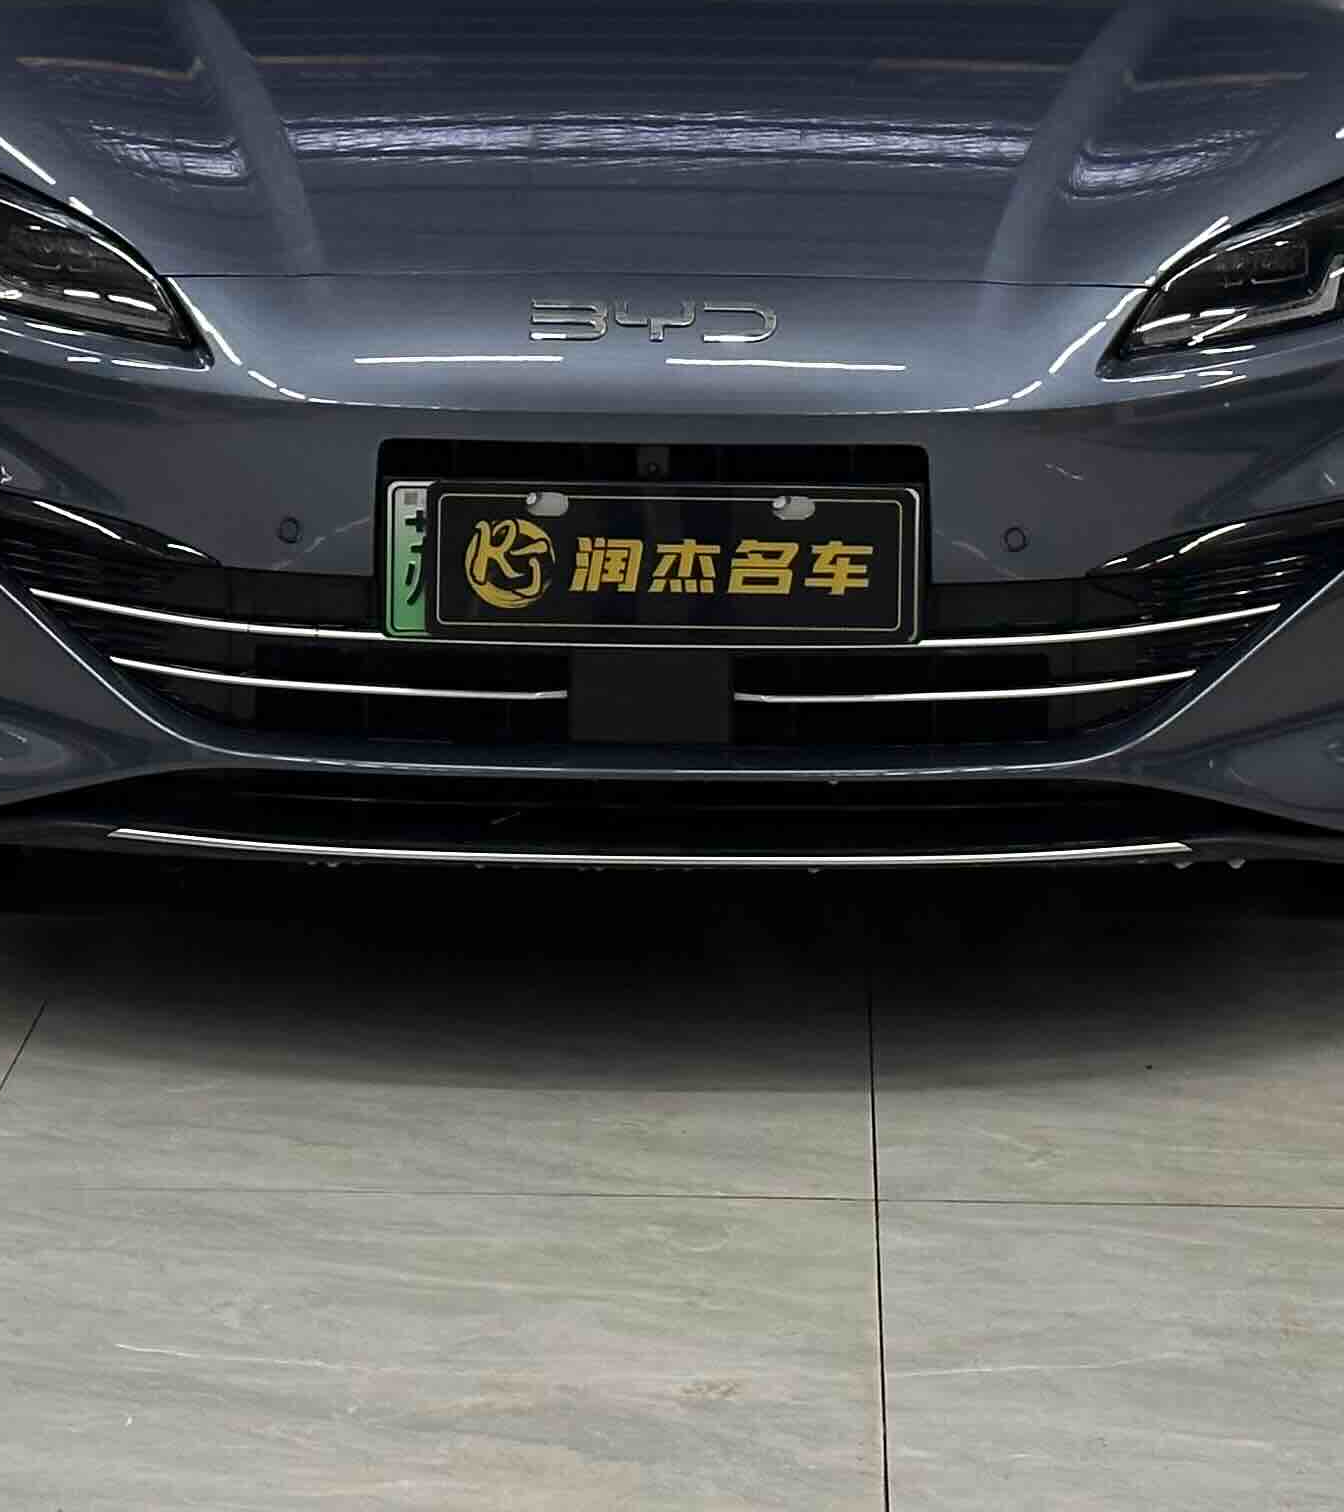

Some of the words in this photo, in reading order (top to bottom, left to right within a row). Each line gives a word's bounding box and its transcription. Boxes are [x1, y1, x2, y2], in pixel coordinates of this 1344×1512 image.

[529, 298, 777, 343] BYD
[568, 536, 874, 595] 润杰名车
